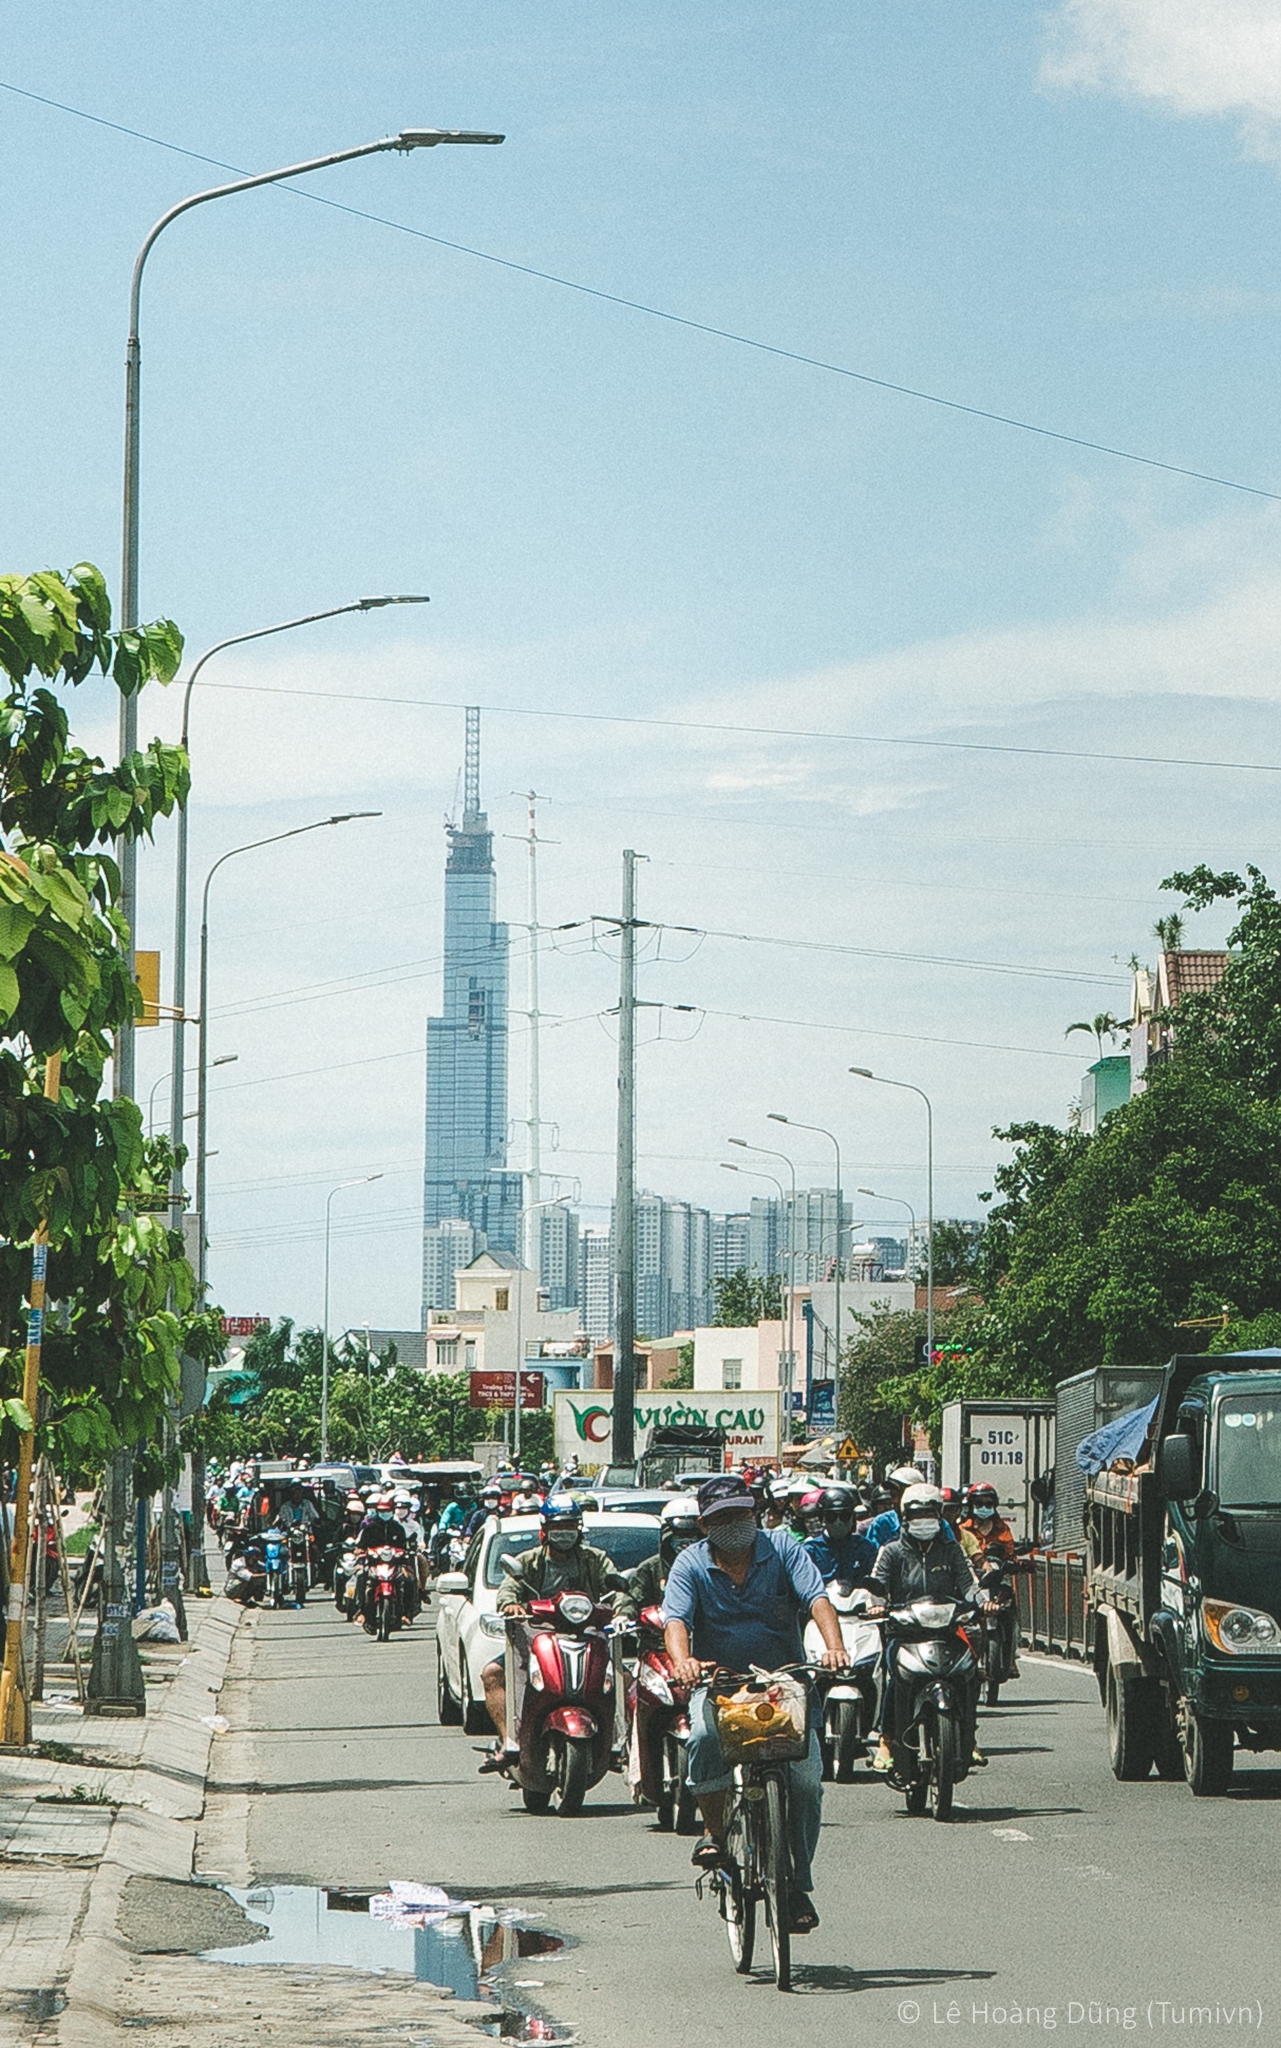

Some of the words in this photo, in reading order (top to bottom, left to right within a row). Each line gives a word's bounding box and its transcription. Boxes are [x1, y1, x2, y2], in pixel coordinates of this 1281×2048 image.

[714, 1408, 765, 1431] CAU
[726, 1434, 765, 1446] URANT
[981, 1451, 1023, 1465] 011.18
